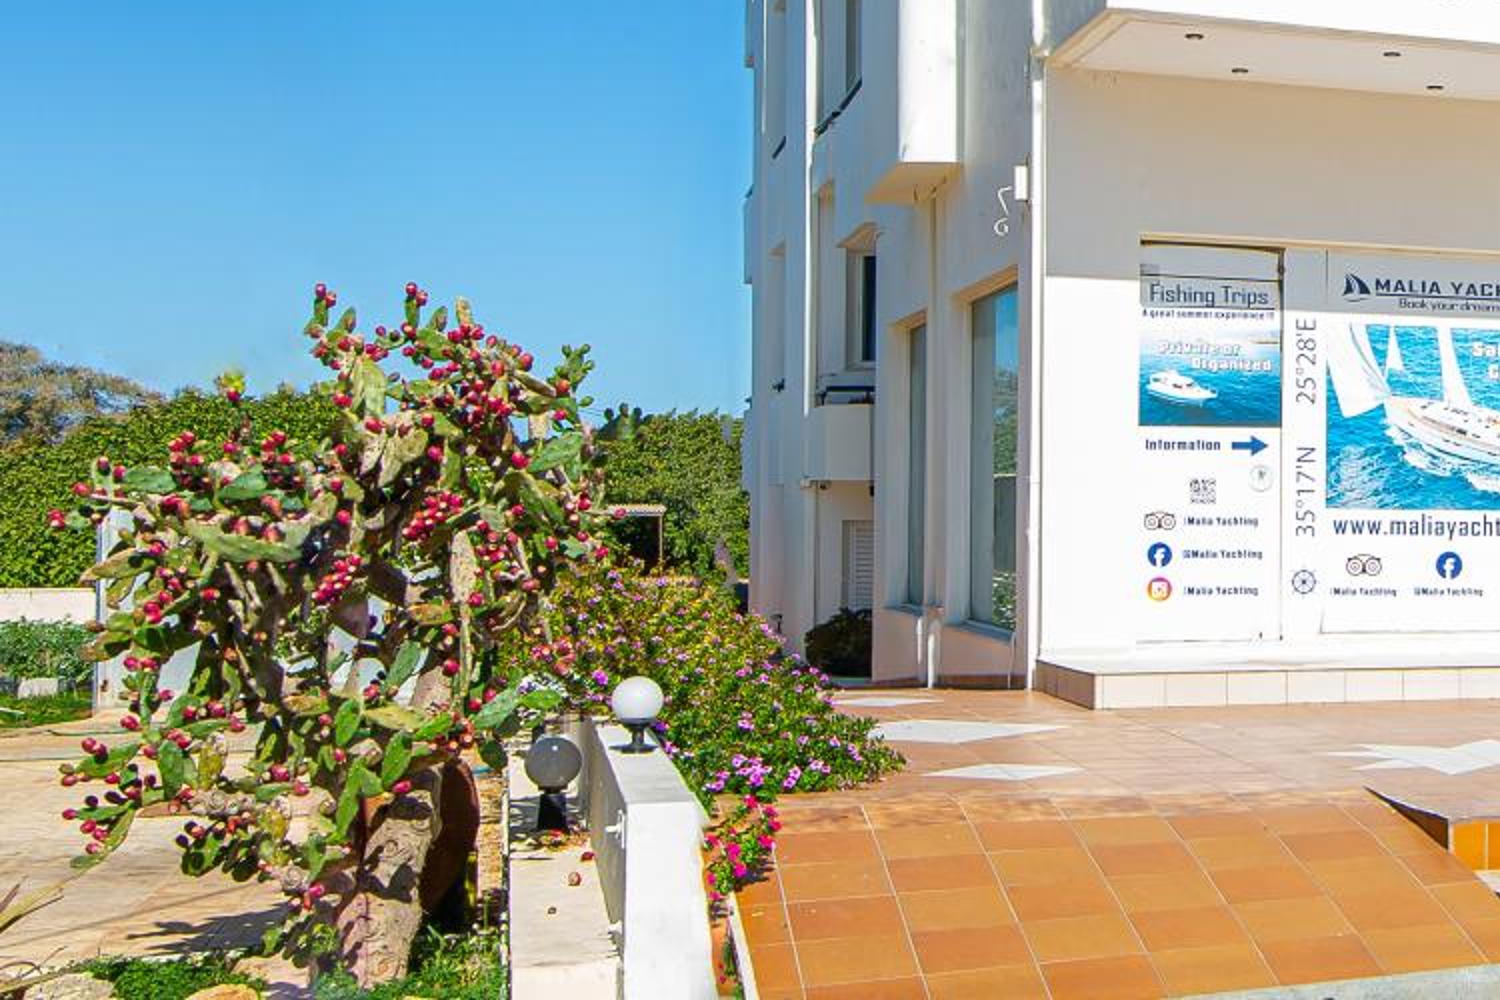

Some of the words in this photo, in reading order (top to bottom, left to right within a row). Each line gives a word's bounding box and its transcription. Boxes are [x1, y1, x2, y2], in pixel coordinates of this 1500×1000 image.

[1375, 278, 1442, 295] MALIA
[1150, 282, 1215, 307] Fishing
[1221, 285, 1269, 308] Trips
[1400, 298, 1428, 310] Book
[1431, 301, 1458, 312] your
[1460, 302, 1500, 313] dream
[1150, 309, 1175, 319] great
[1178, 310, 1212, 318] summer
[1215, 311, 1264, 320] experience
[1158, 341, 1220, 357] Private
[1190, 357, 1273, 374] Organized
[1145, 439, 1221, 451] Information
[1216, 516, 1259, 528] Yachting
[1220, 549, 1263, 561] Yachting
[1216, 586, 1259, 597] Yachting
[1360, 587, 1397, 597] Yachting
[1447, 587, 1484, 597] Yachting
